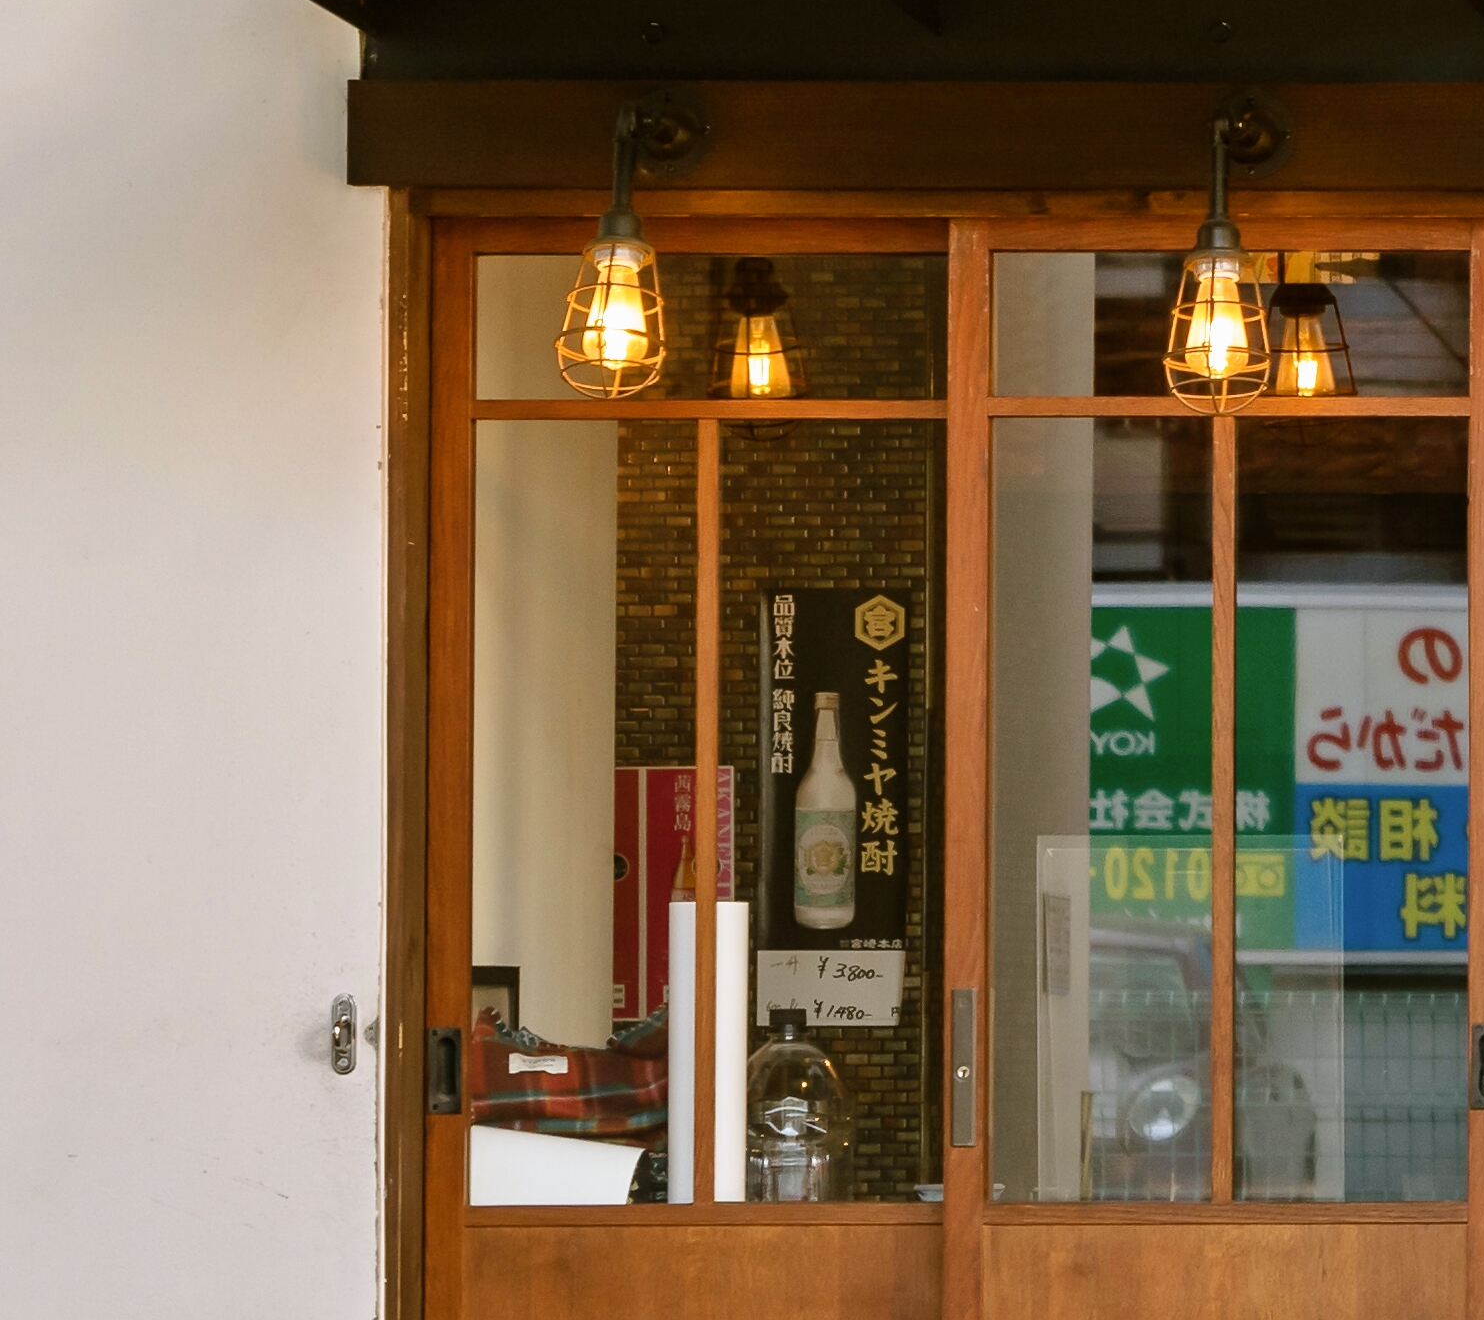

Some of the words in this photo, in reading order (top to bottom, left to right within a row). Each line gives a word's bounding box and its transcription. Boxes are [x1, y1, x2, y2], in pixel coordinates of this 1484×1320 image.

[773, 594, 796, 680] 品質本位
[674, 774, 692, 832] 茜霧島
[861, 658, 899, 876] キンミヤ焼酎
